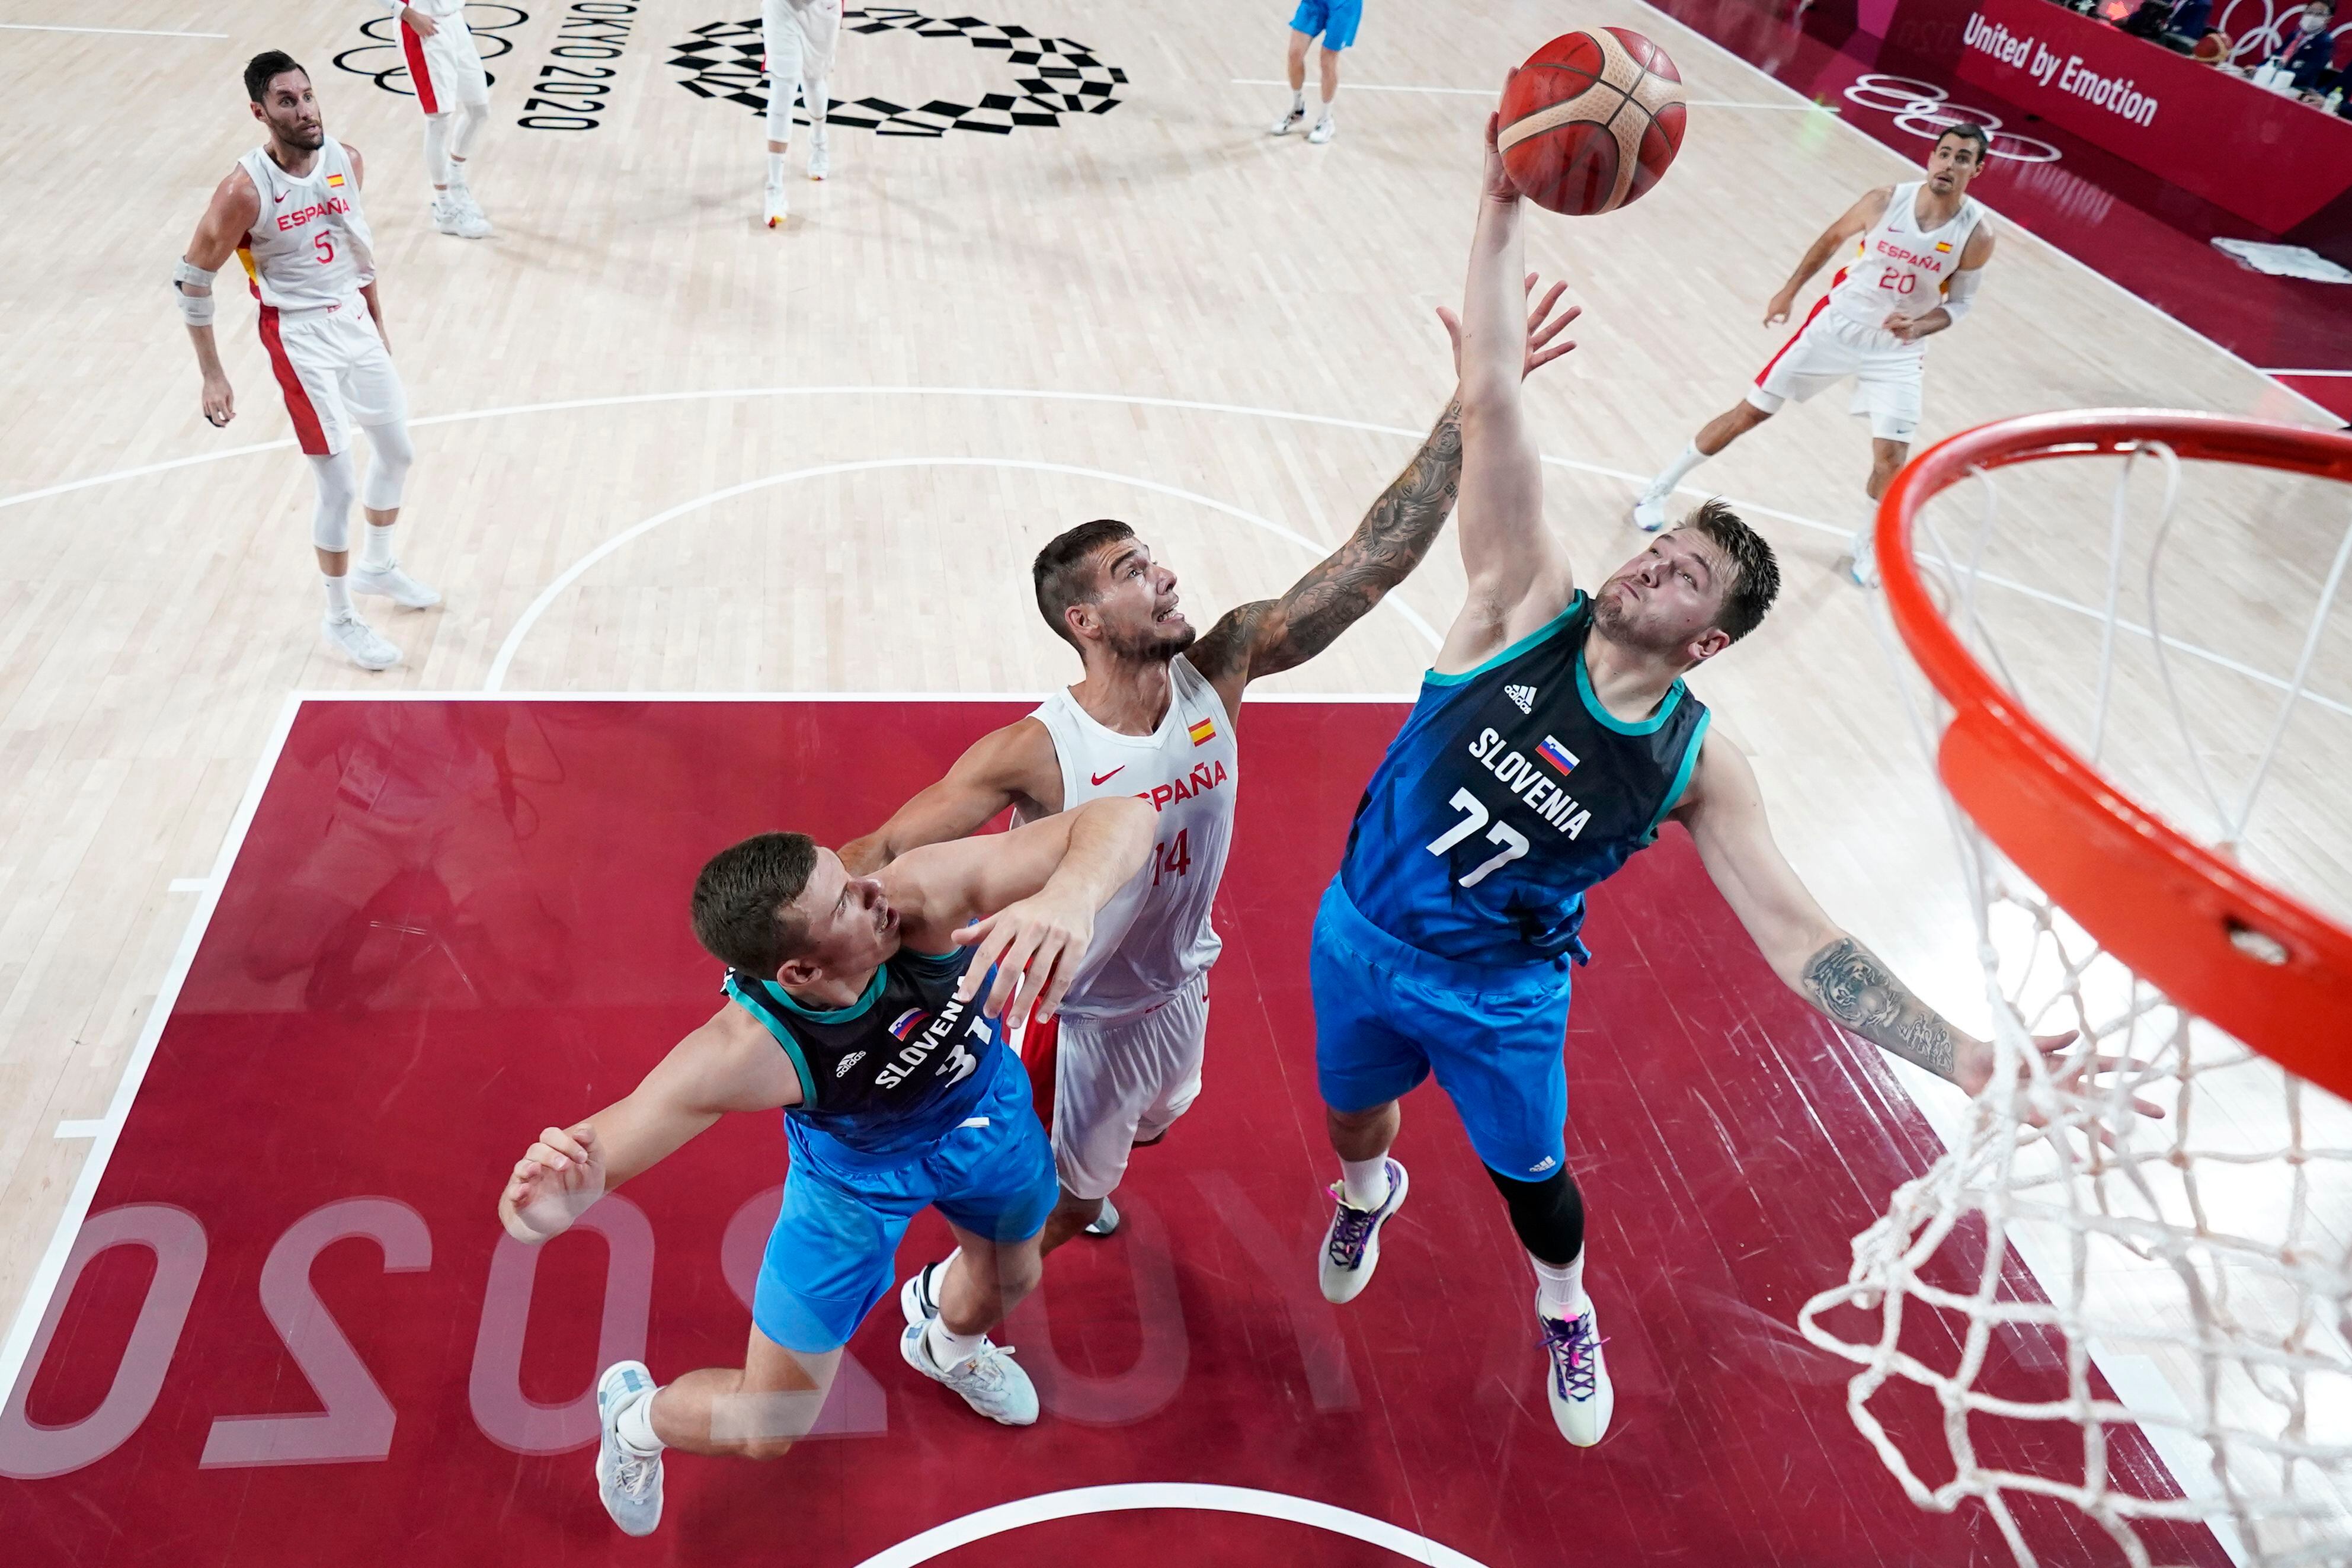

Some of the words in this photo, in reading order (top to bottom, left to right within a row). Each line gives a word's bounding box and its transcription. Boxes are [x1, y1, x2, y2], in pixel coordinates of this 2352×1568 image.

[550, 0, 640, 58] OKYO
[517, 65, 616, 130] 2020
[1962, 12, 2034, 69] United
[2029, 42, 2062, 87] by
[2058, 55, 2158, 127] Emotion
[277, 197, 350, 232] ESPAÑA
[314, 230, 334, 264] 5
[1877, 240, 1941, 273] ESPAÑA
[1879, 266, 1916, 294] 20
[1504, 685, 1532, 715] adidas
[1132, 760, 1228, 812] PAÑA
[1468, 727, 1592, 841] SLOVENIA
[1152, 827, 1191, 886] 14
[1426, 786, 1530, 888] 77
[875, 975, 966, 1089] SLOVEN
[935, 1015, 993, 1088] 31
[836, 1050, 866, 1078] adidas
